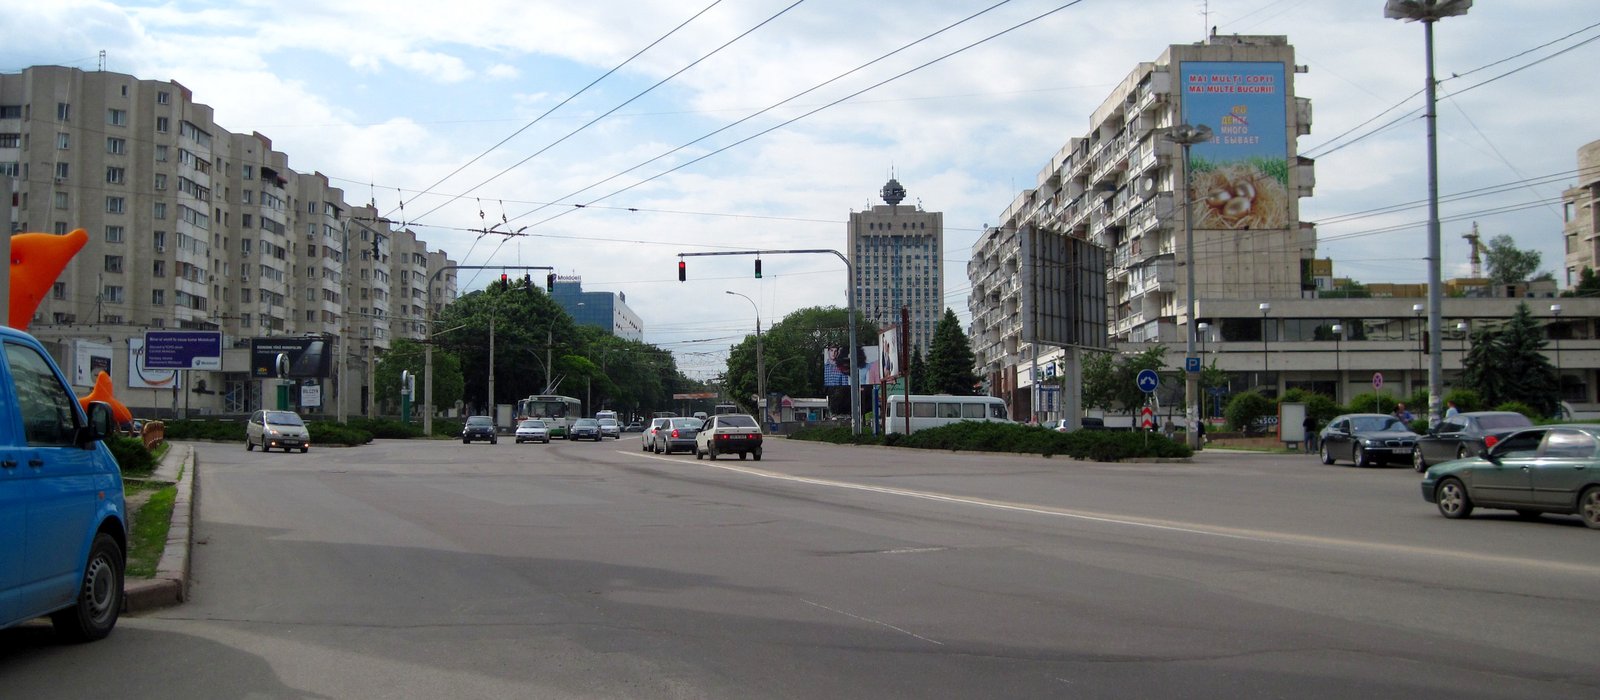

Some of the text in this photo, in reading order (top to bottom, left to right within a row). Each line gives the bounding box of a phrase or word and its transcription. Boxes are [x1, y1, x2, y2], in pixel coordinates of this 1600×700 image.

[1189, 85, 1204, 93] MAI
[1207, 85, 1235, 93] MULTE
[1221, 126, 1248, 134] МНОГО
[1224, 136, 1260, 144] БЫВАЕТ
[1189, 360, 1198, 370] P
